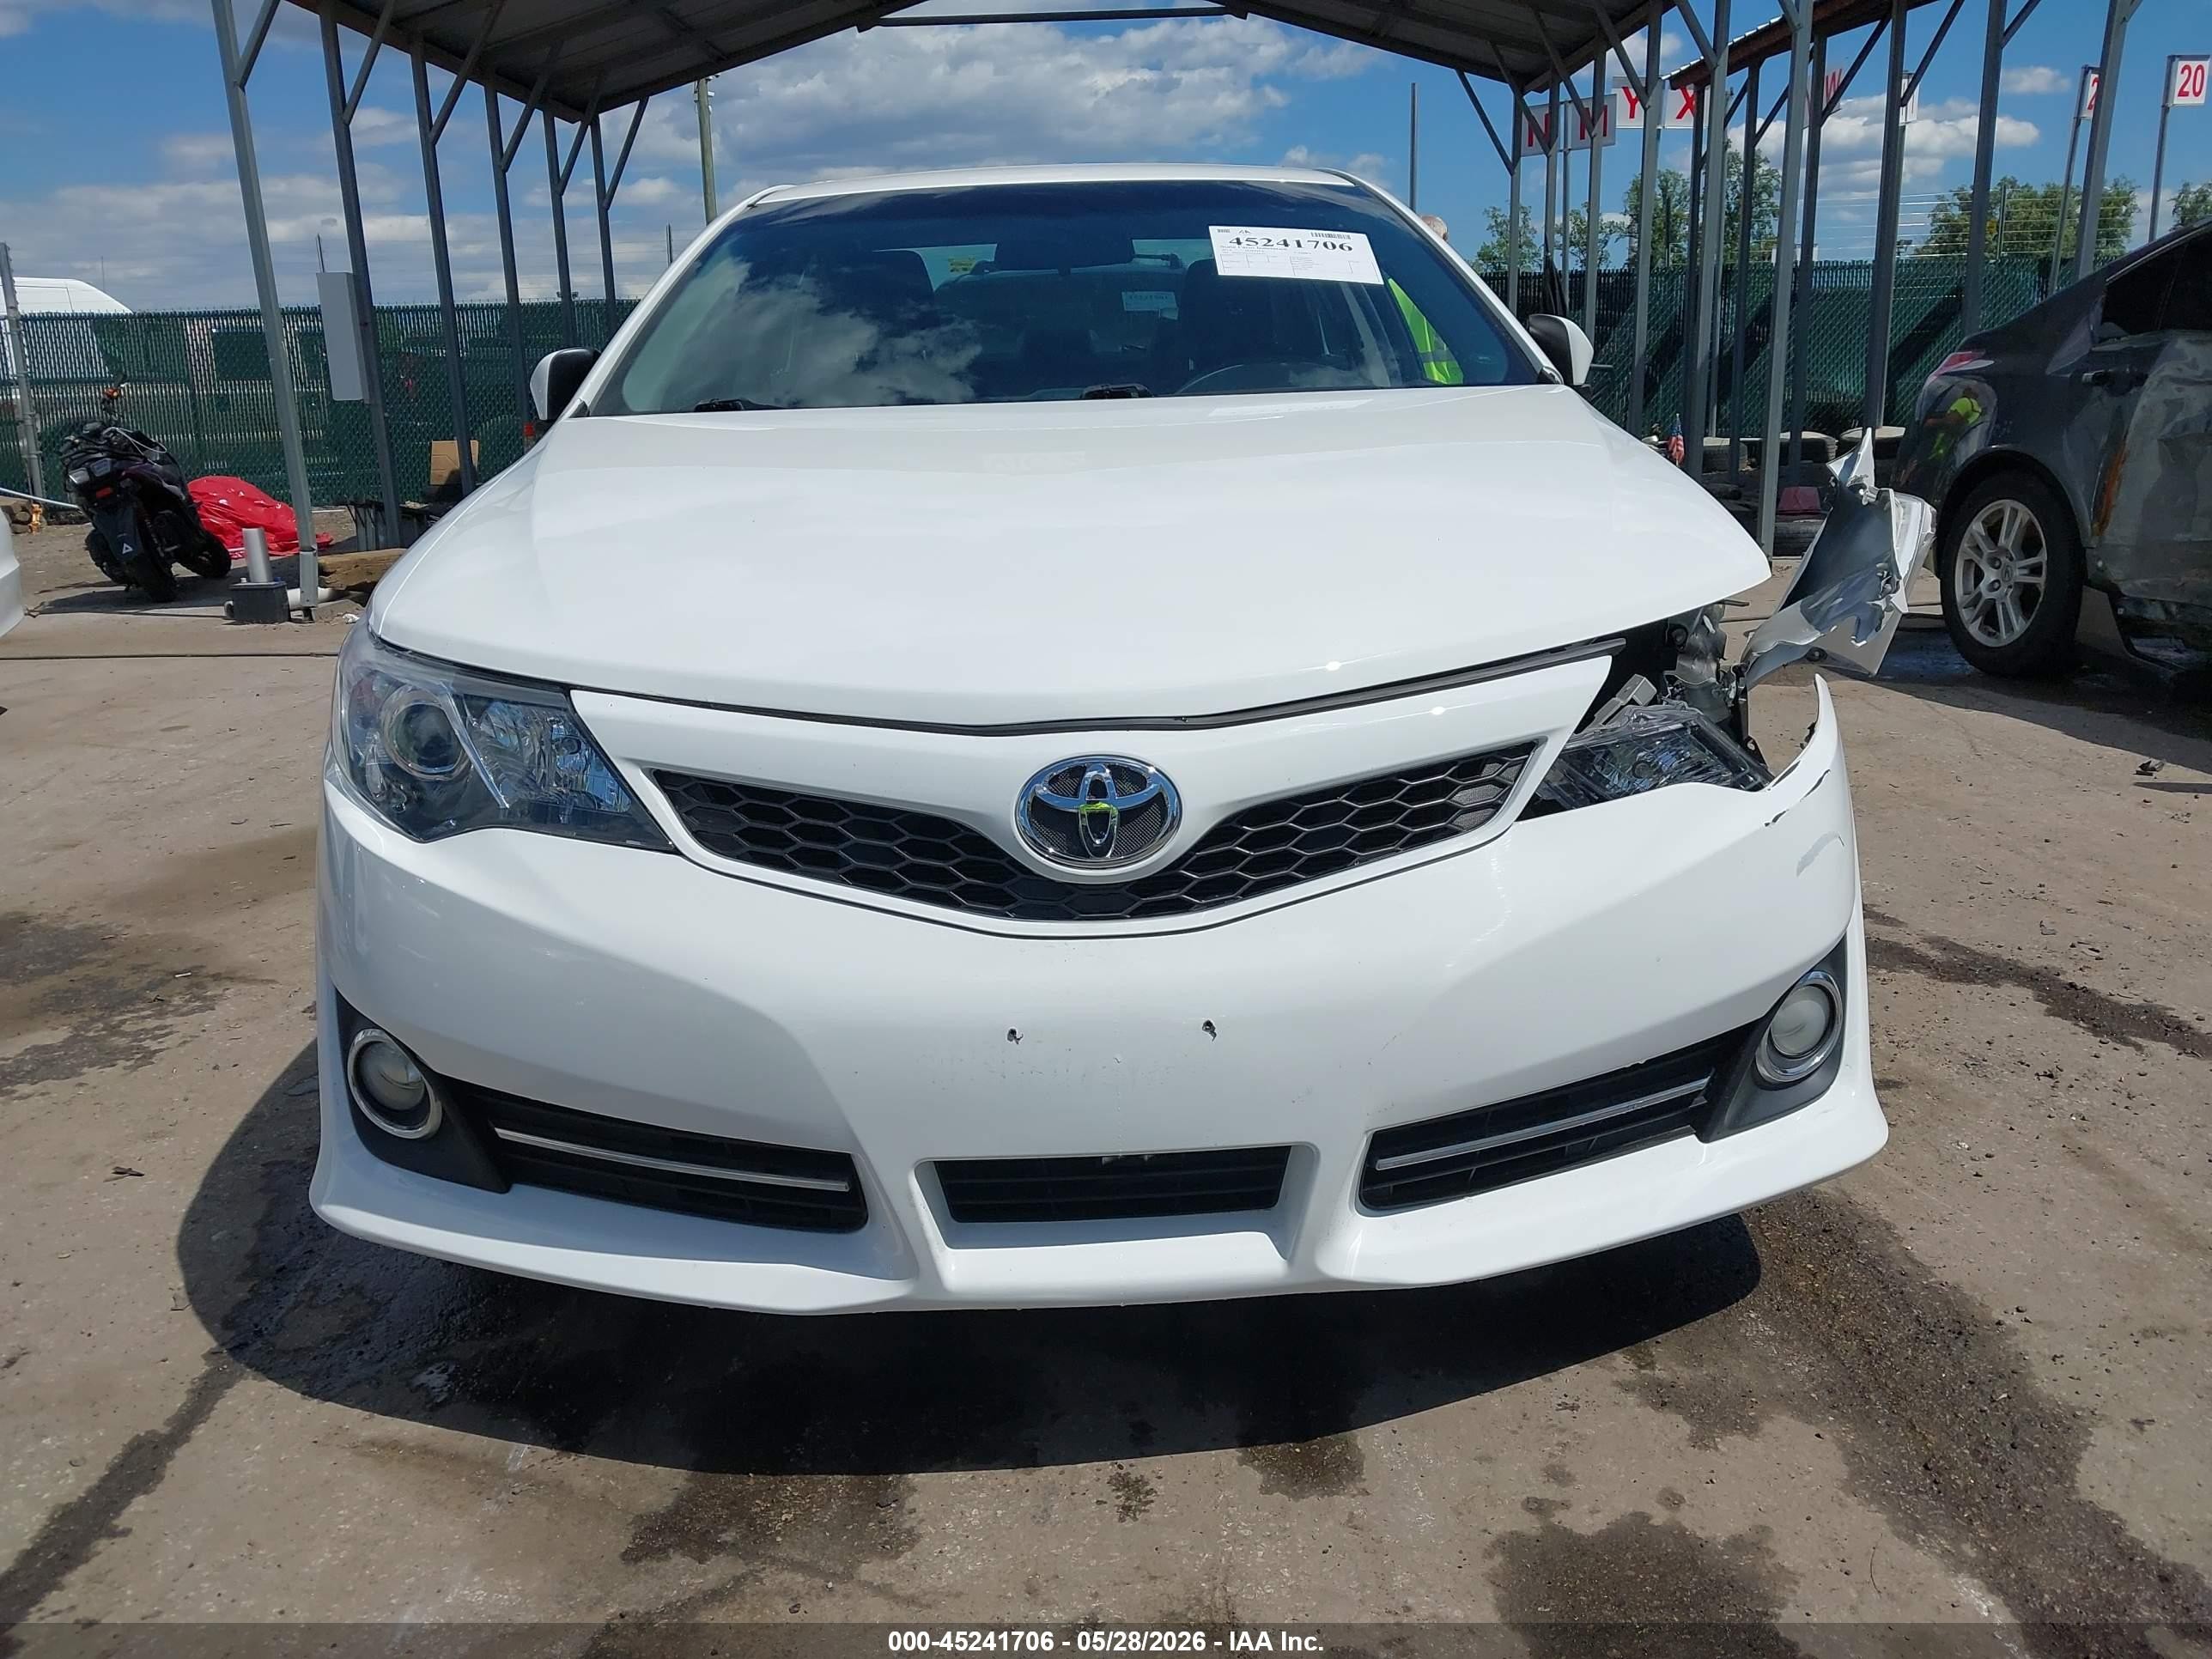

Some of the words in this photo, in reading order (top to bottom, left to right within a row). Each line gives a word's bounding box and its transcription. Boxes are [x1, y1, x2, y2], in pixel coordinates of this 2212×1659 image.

[2178, 64, 2205, 98] 20
[1621, 86, 1640, 119] Y
[1675, 86, 1697, 120] X
[1229, 237, 1353, 252] 45241706
